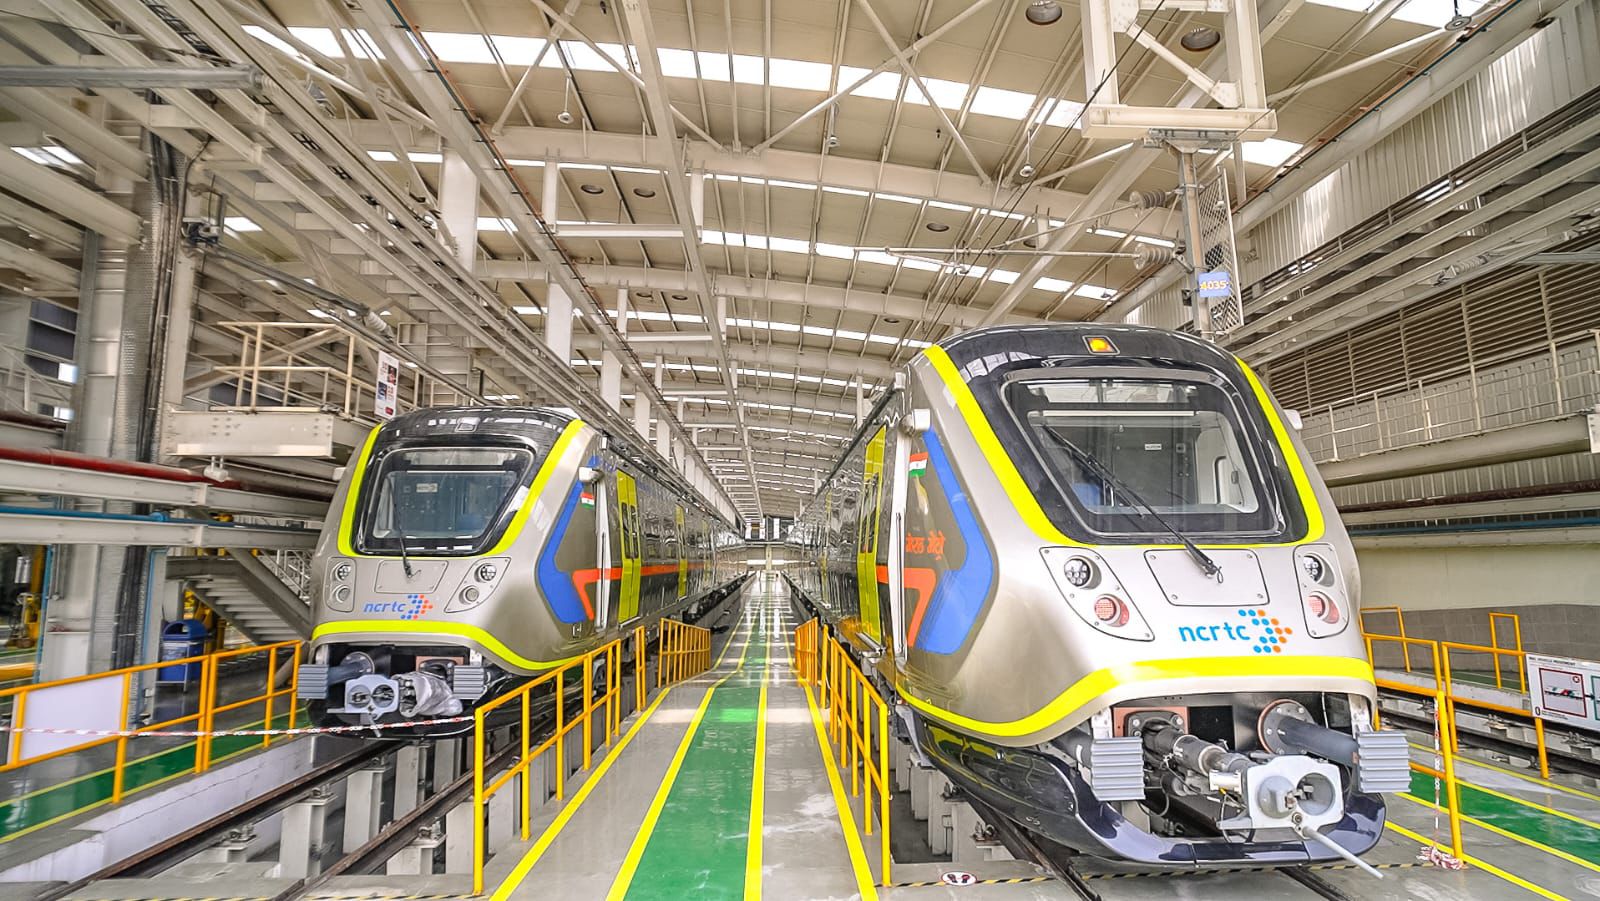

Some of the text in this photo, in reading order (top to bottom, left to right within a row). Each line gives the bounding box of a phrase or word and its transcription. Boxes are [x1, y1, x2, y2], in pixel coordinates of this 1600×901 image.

[1199, 280, 1226, 290] 4035
[364, 601, 406, 613] ncrtc
[1178, 622, 1251, 642] ncrtc
